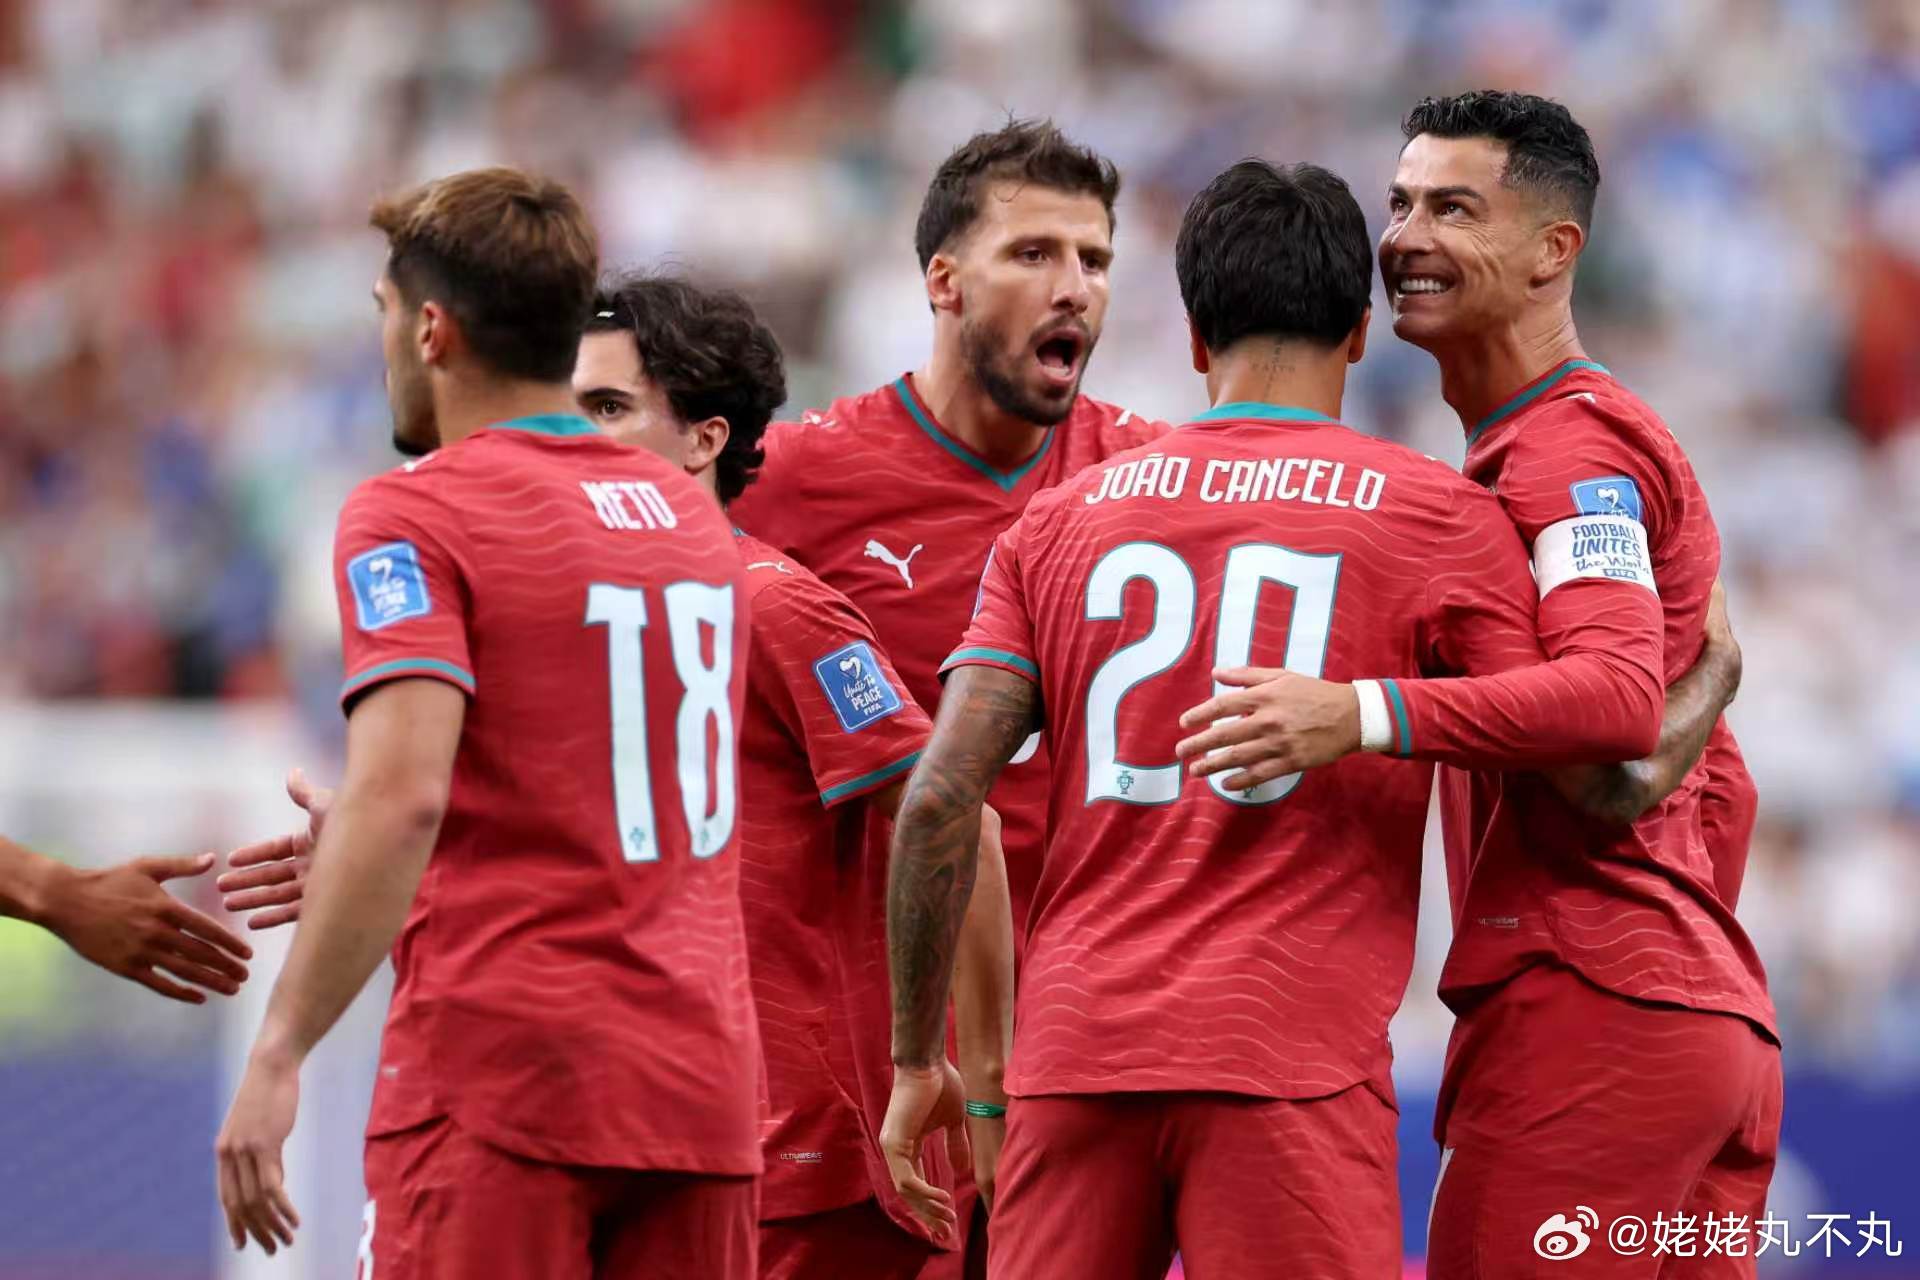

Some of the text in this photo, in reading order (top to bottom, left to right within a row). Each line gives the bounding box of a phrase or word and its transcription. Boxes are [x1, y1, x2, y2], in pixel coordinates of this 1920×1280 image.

[1085, 453, 1386, 511] JOÃO CANCELO
[580, 481, 678, 530] NETO
[1572, 523, 1640, 542] FOOTBALL
[1572, 538, 1643, 559] UNITES
[1084, 541, 1343, 808] 20
[851, 685, 884, 711] PEACE
[863, 703, 882, 717] FIFA
[584, 580, 736, 864] 18
